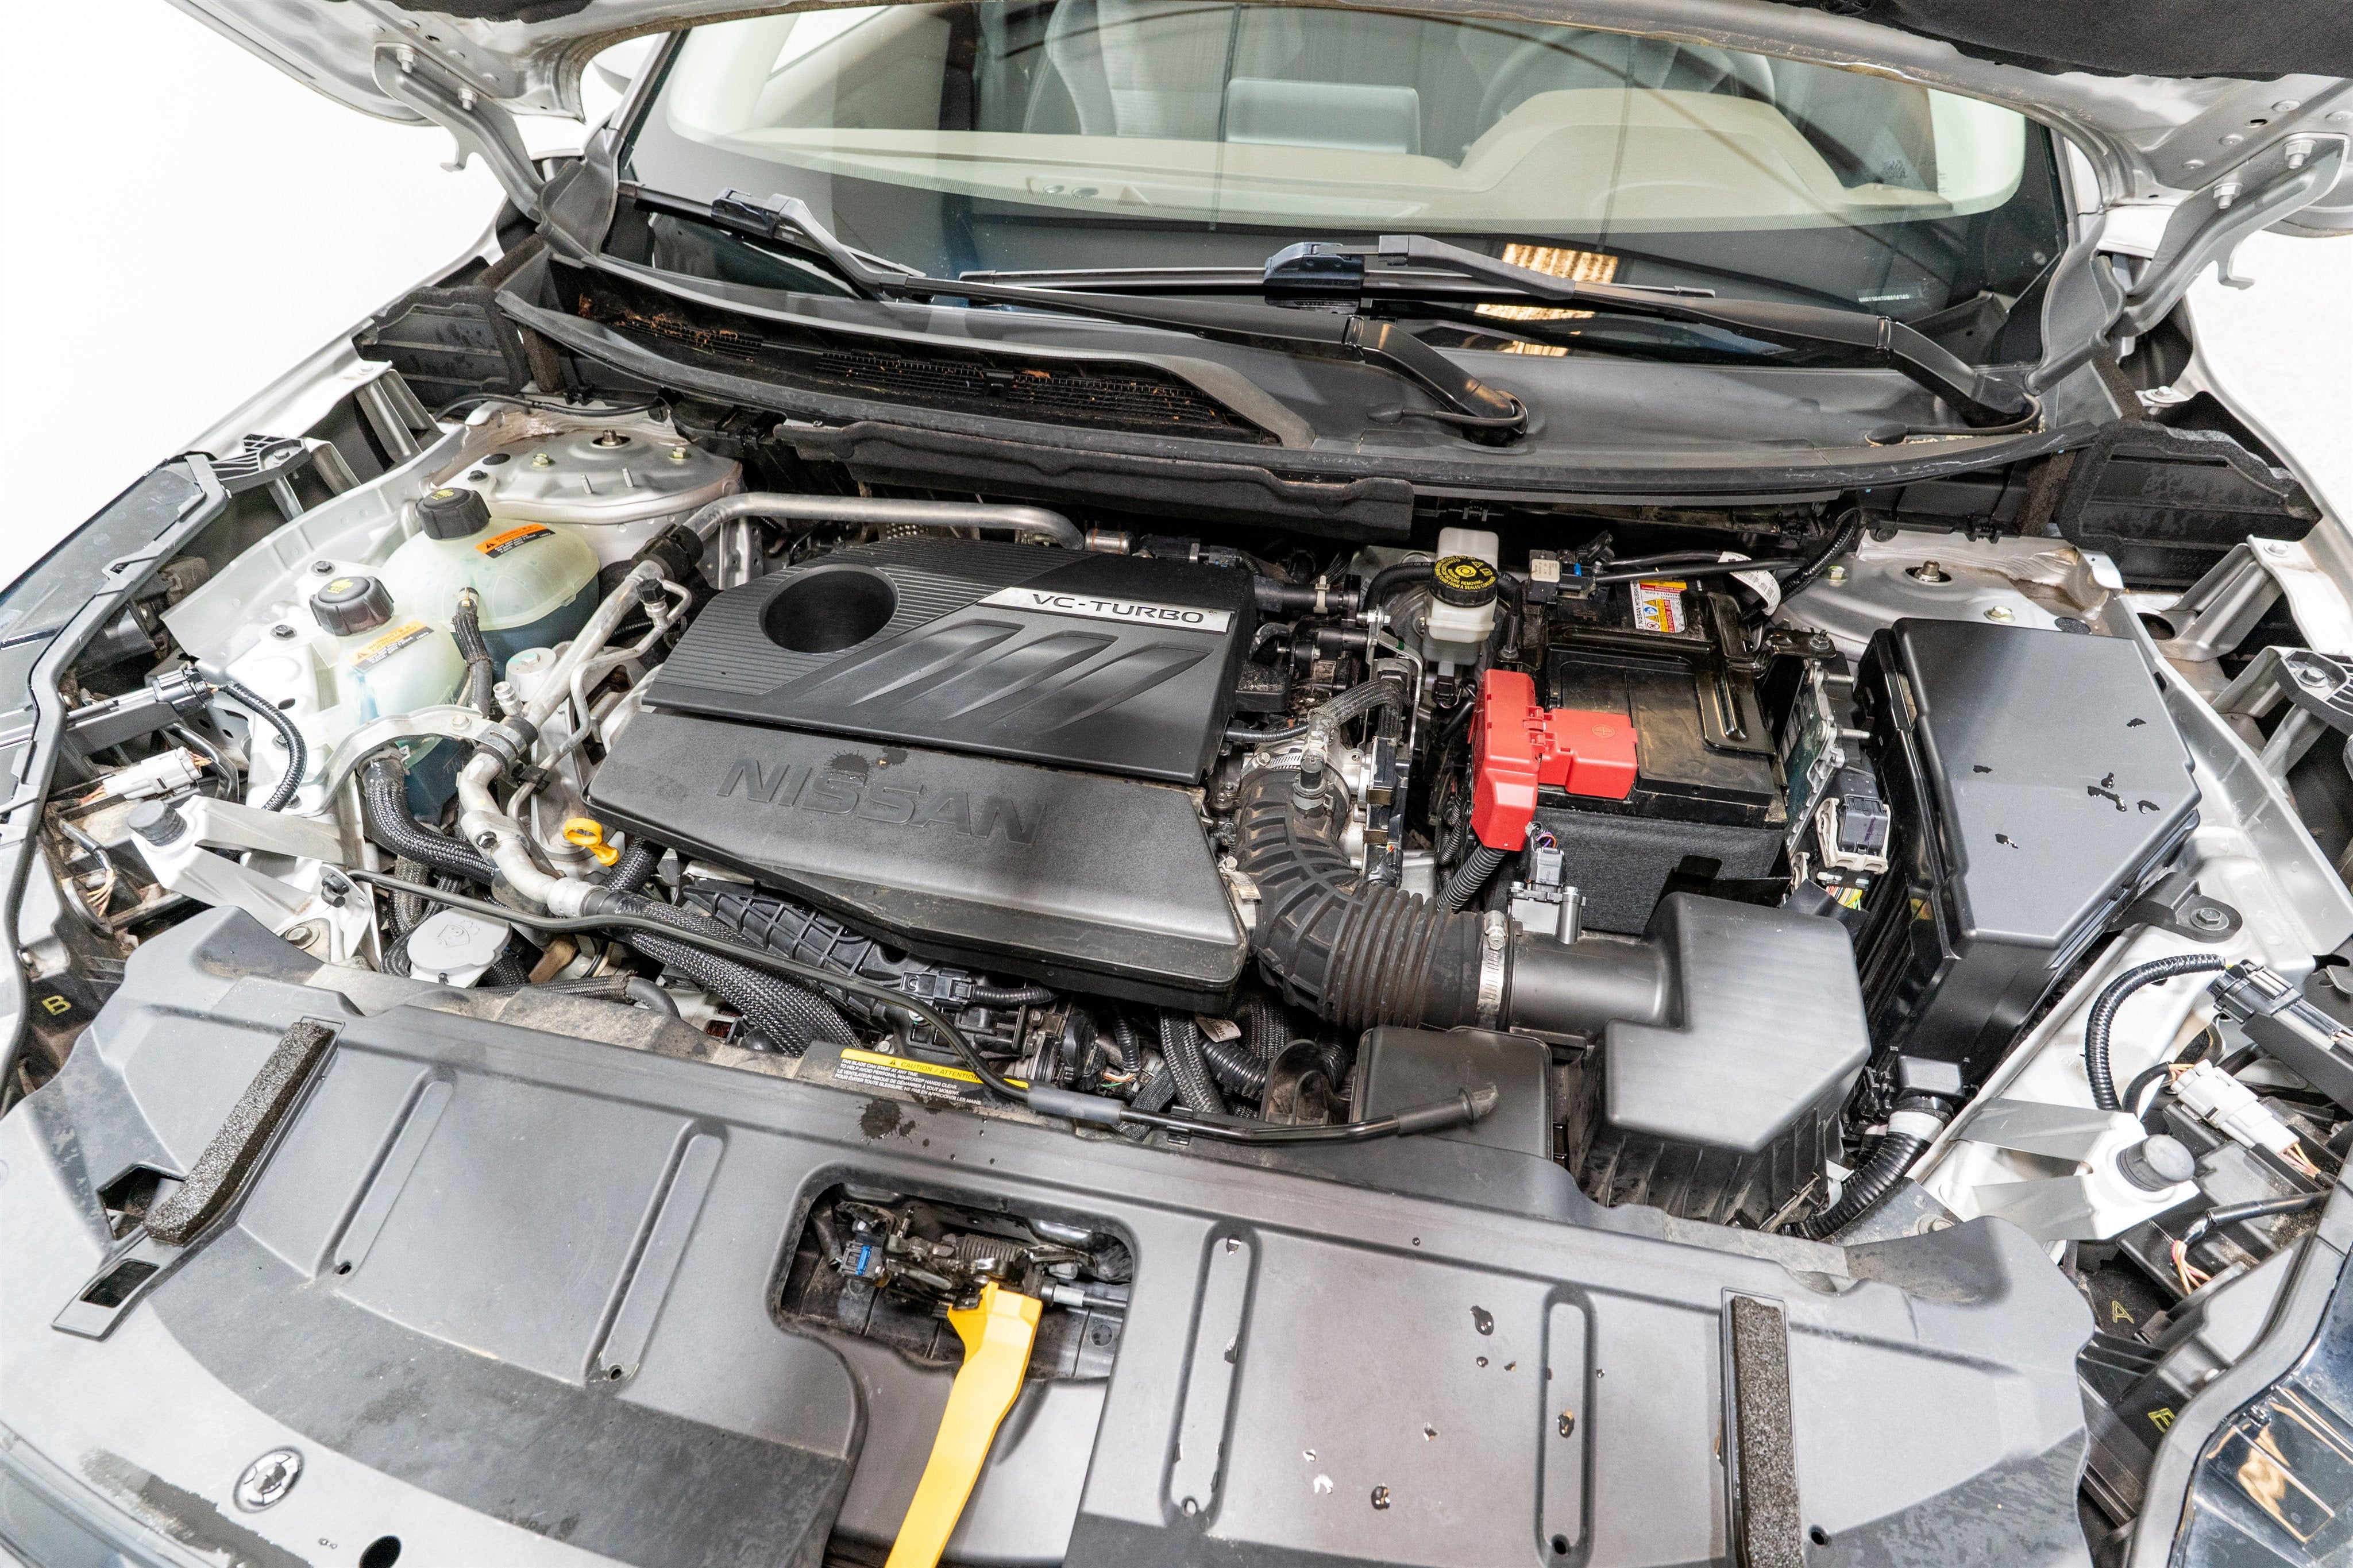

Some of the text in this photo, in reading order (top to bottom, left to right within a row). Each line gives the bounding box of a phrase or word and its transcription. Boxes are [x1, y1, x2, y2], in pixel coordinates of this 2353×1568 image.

[1032, 593, 1205, 623] VC-TURBO
[716, 758, 1048, 845] NISSAN
[41, 995, 72, 1016] B
[843, 1070, 872, 1080] VENTILATEUR
[897, 1079, 921, 1089] DÉMARRER
[938, 1087, 960, 1096] MOMENT.
[873, 1069, 897, 1079] PERSONAL
[924, 1079, 942, 1087] HANDS
[941, 1082, 958, 1090] CLEAR.
[900, 1061, 933, 1072] CAUTION
[939, 1069, 979, 1082] ATTENTION
[848, 1075, 863, 1083] ÉVITER
[927, 1090, 957, 1101] APPROCHER
[966, 1098, 982, 1106] MAINS.
[2112, 1300, 2135, 1324] A
